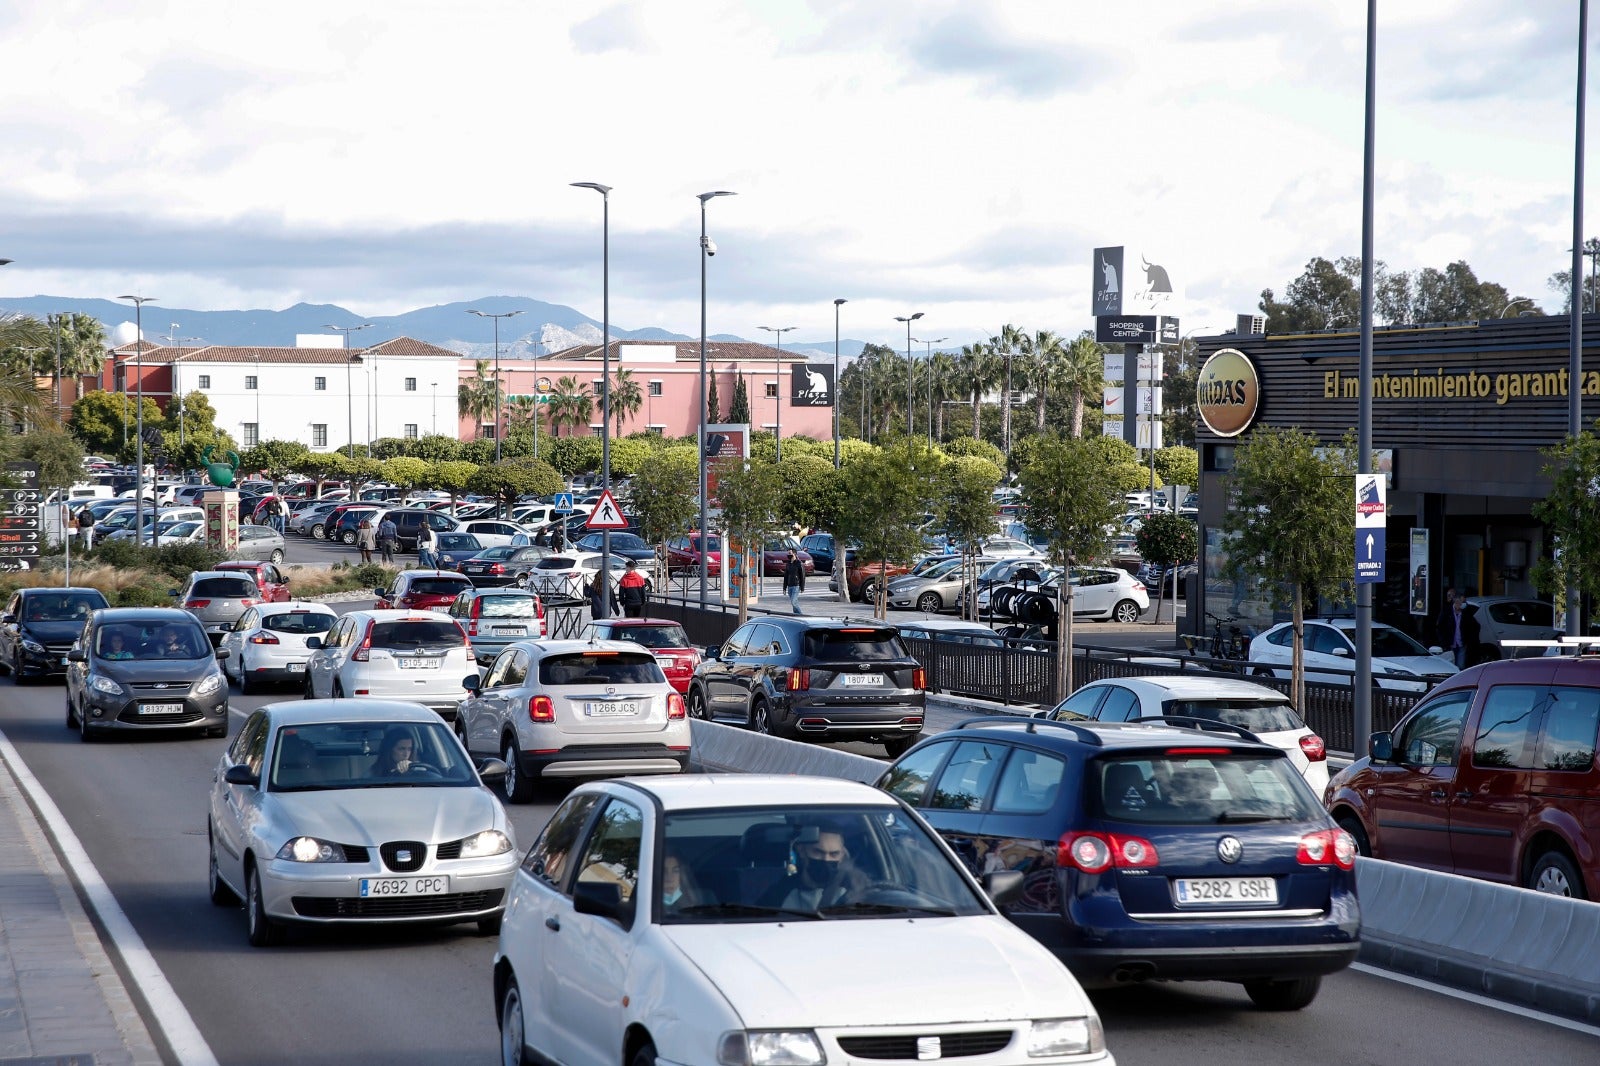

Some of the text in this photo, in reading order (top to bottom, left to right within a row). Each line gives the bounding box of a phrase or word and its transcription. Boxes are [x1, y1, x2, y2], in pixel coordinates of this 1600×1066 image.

[1324, 366, 1600, 405] El mntenimiento garantza
[798, 389, 828, 405] Plaza
[1357, 503, 1384, 512] Designer Outlet
[1358, 562, 1378, 570] ENTRADA
[403, 659, 438, 667] 5105 JHY
[848, 676, 881, 684] 1807 LKX
[145, 705, 165, 713] 8137
[593, 703, 635, 713] 1266 JCS
[373, 878, 442, 895] 4692 CPC
[1191, 880, 1271, 899] 5282 GSH
